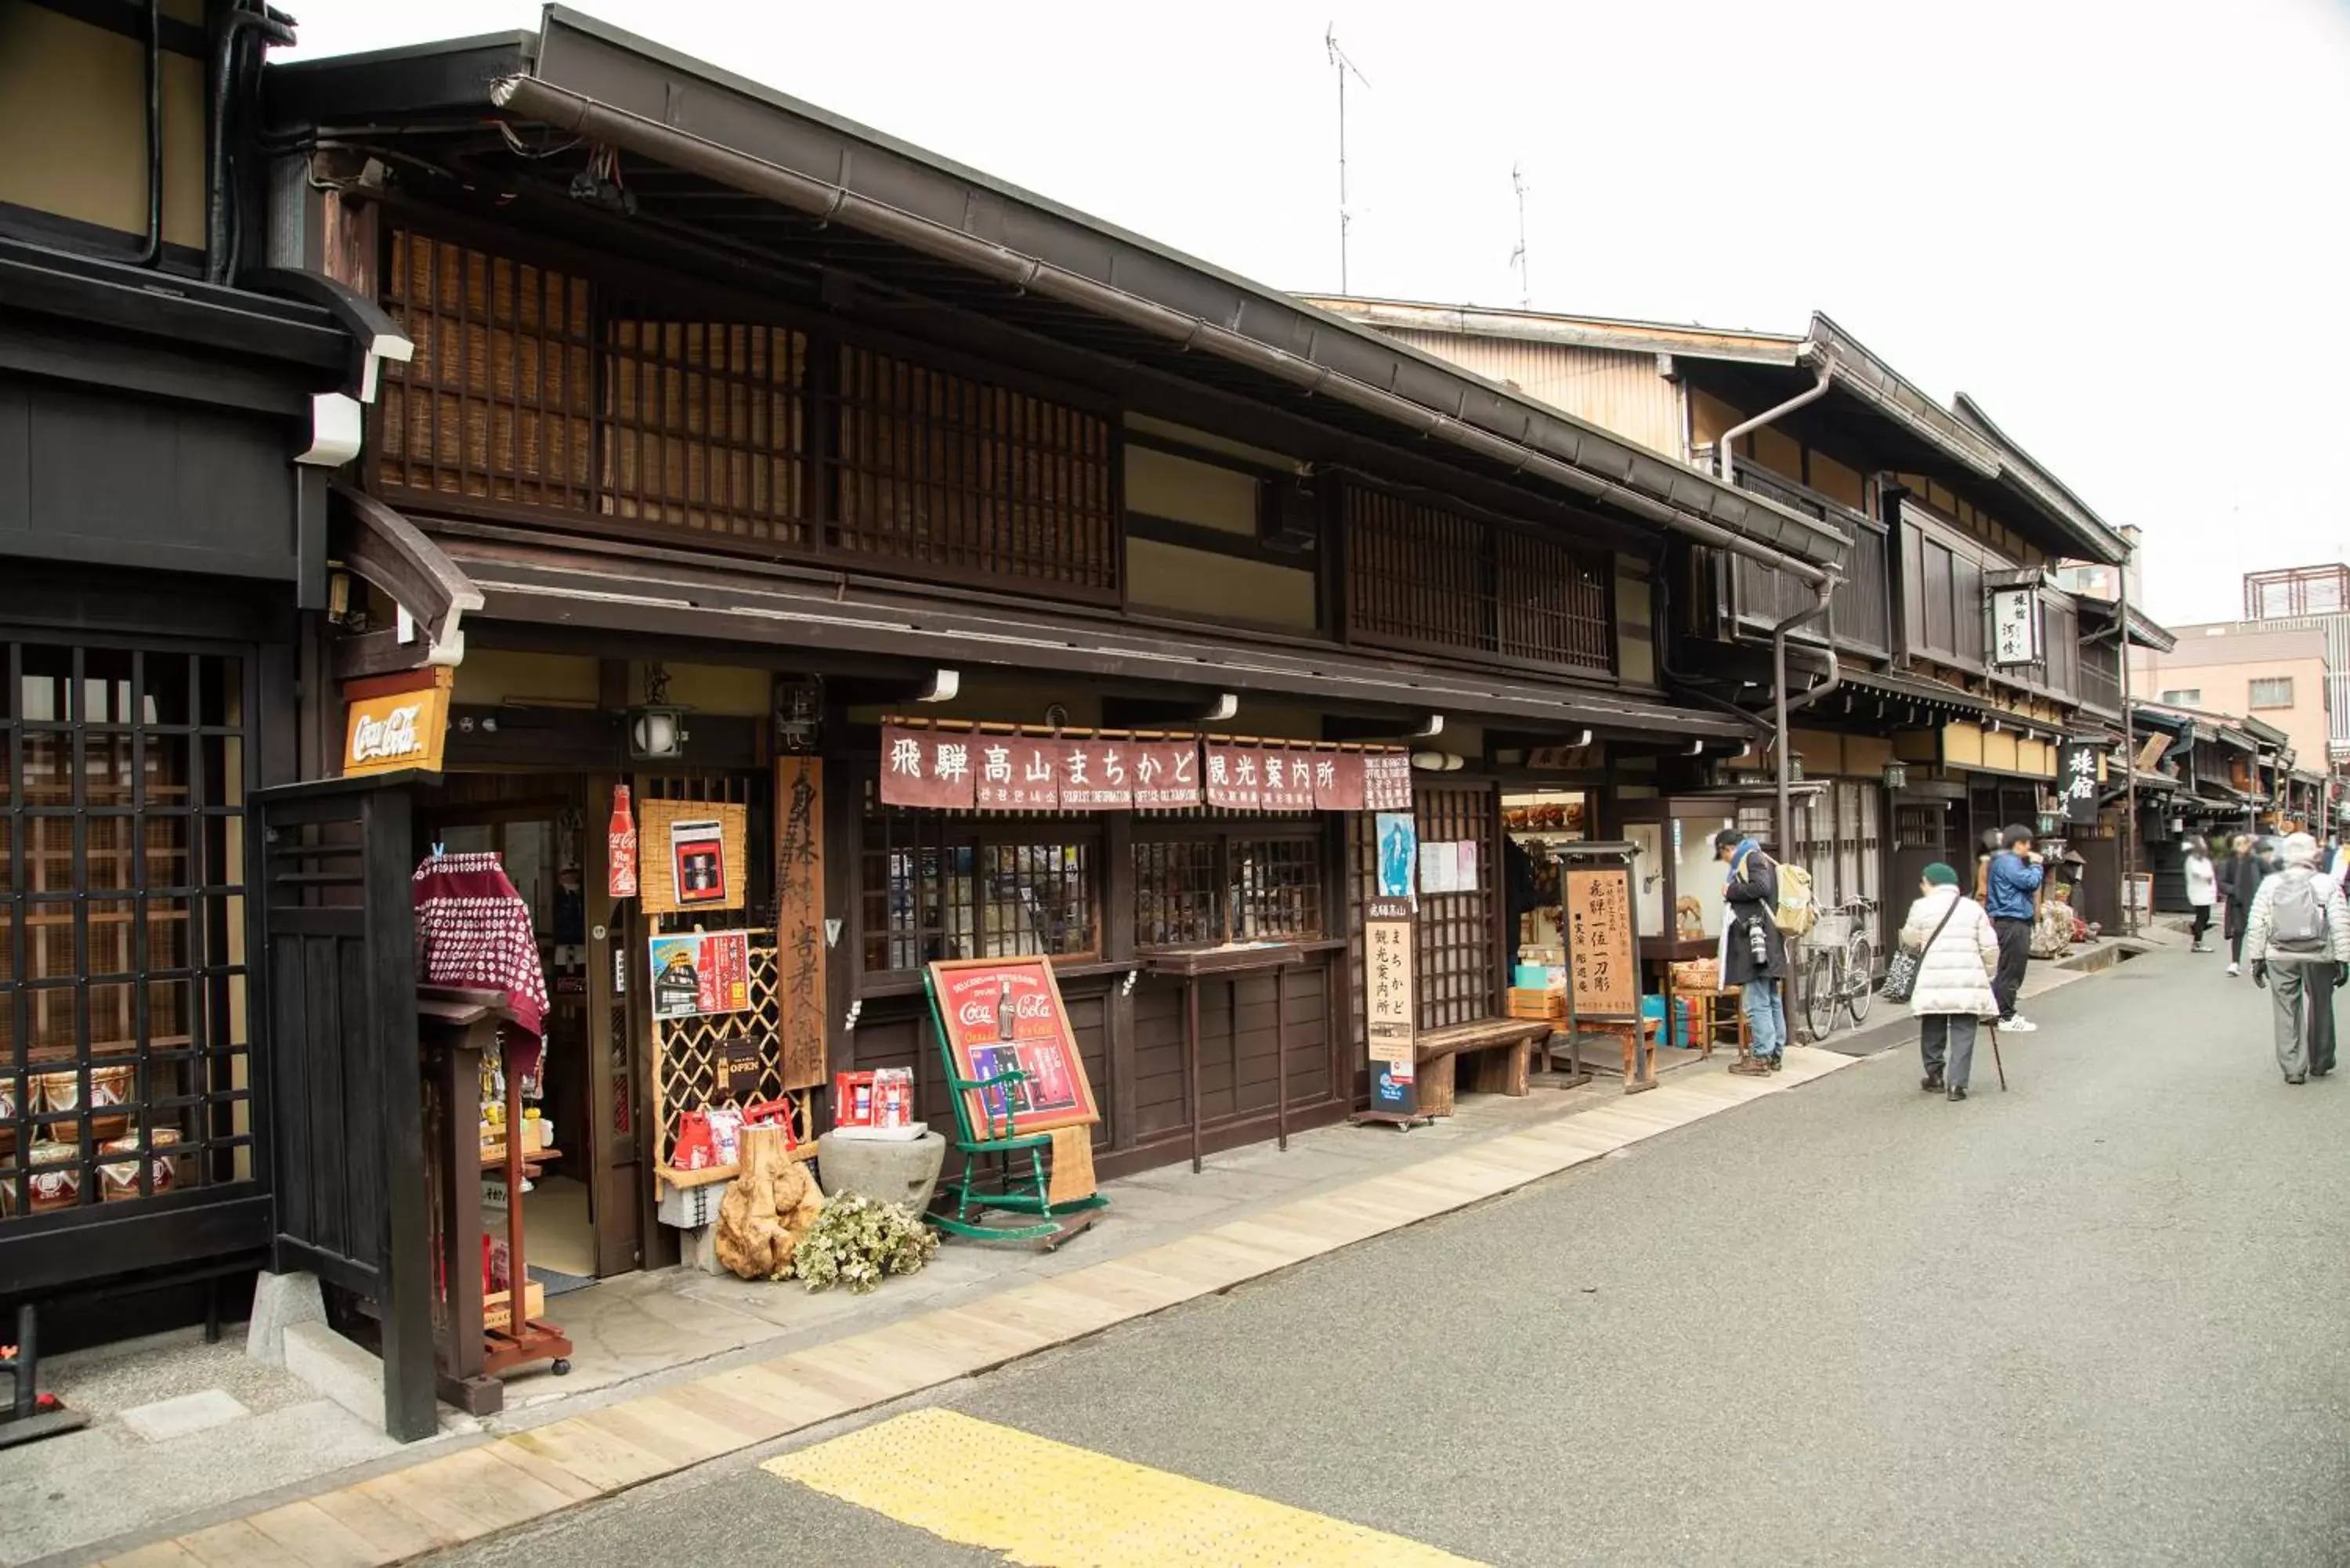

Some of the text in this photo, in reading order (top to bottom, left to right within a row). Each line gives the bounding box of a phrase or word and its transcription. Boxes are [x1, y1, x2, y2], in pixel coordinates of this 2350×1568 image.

[2012, 593, 2027, 620] 旅館
[2069, 748, 2097, 799] 旅館
[959, 993, 1052, 1026] Coca Cola
[729, 1061, 759, 1073] OPEN
